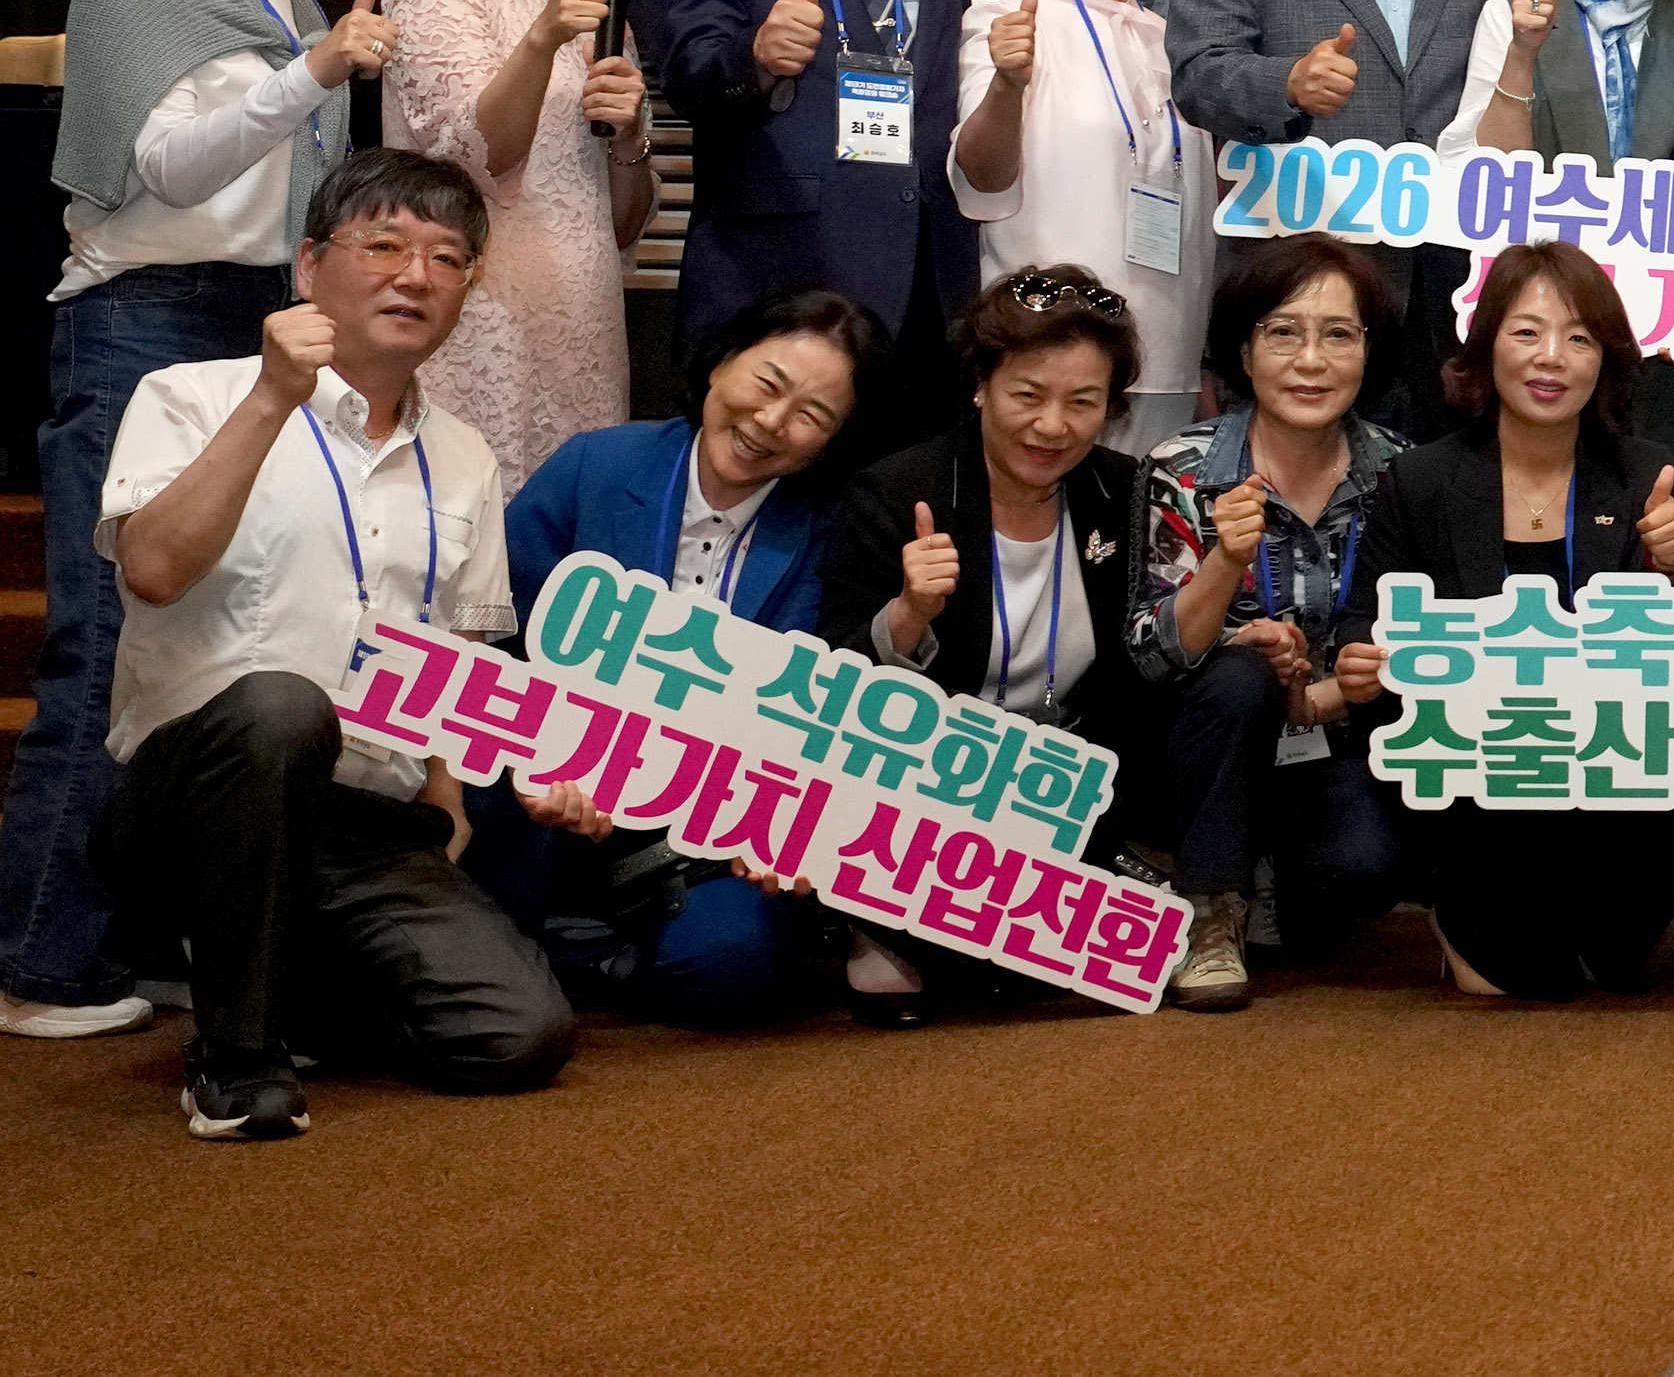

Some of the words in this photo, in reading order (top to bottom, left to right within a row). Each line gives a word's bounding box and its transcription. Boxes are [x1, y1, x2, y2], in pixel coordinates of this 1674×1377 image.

[1224, 145, 1429, 237] 2026
[335, 624, 832, 877] 고부가가치
[832, 802, 1184, 1002] 산업전환
[541, 567, 732, 710] 여수
[757, 646, 1107, 853] 석유화학
